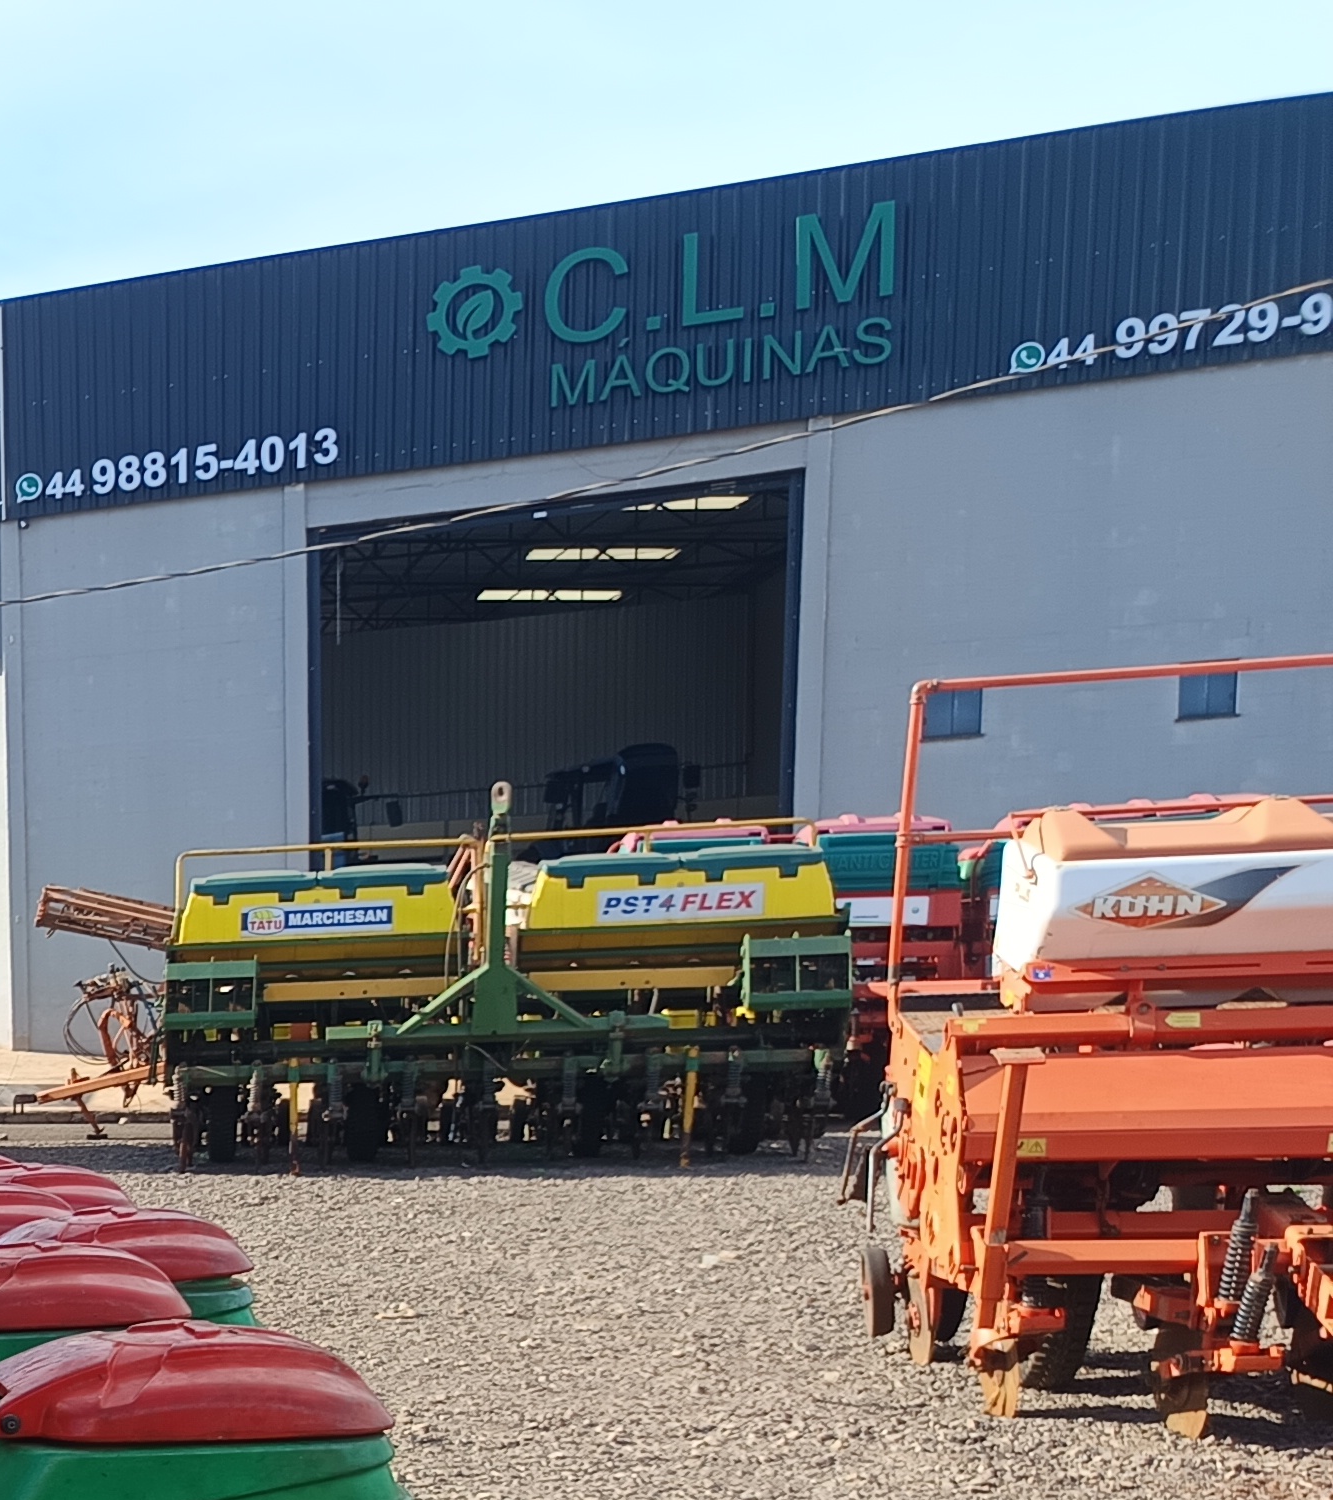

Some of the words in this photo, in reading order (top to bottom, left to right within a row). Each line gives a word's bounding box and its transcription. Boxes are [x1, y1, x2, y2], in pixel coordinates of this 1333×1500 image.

[544, 200, 895, 343] C.L.M
[550, 316, 893, 408] MÁQUINAS
[1046, 333, 1099, 370] 44
[45, 468, 85, 499] 44
[91, 427, 339, 495] 98815-4013
[249, 919, 283, 932] TATU
[288, 908, 389, 927] MARCHESAN
[1093, 895, 1203, 918] KUHN
